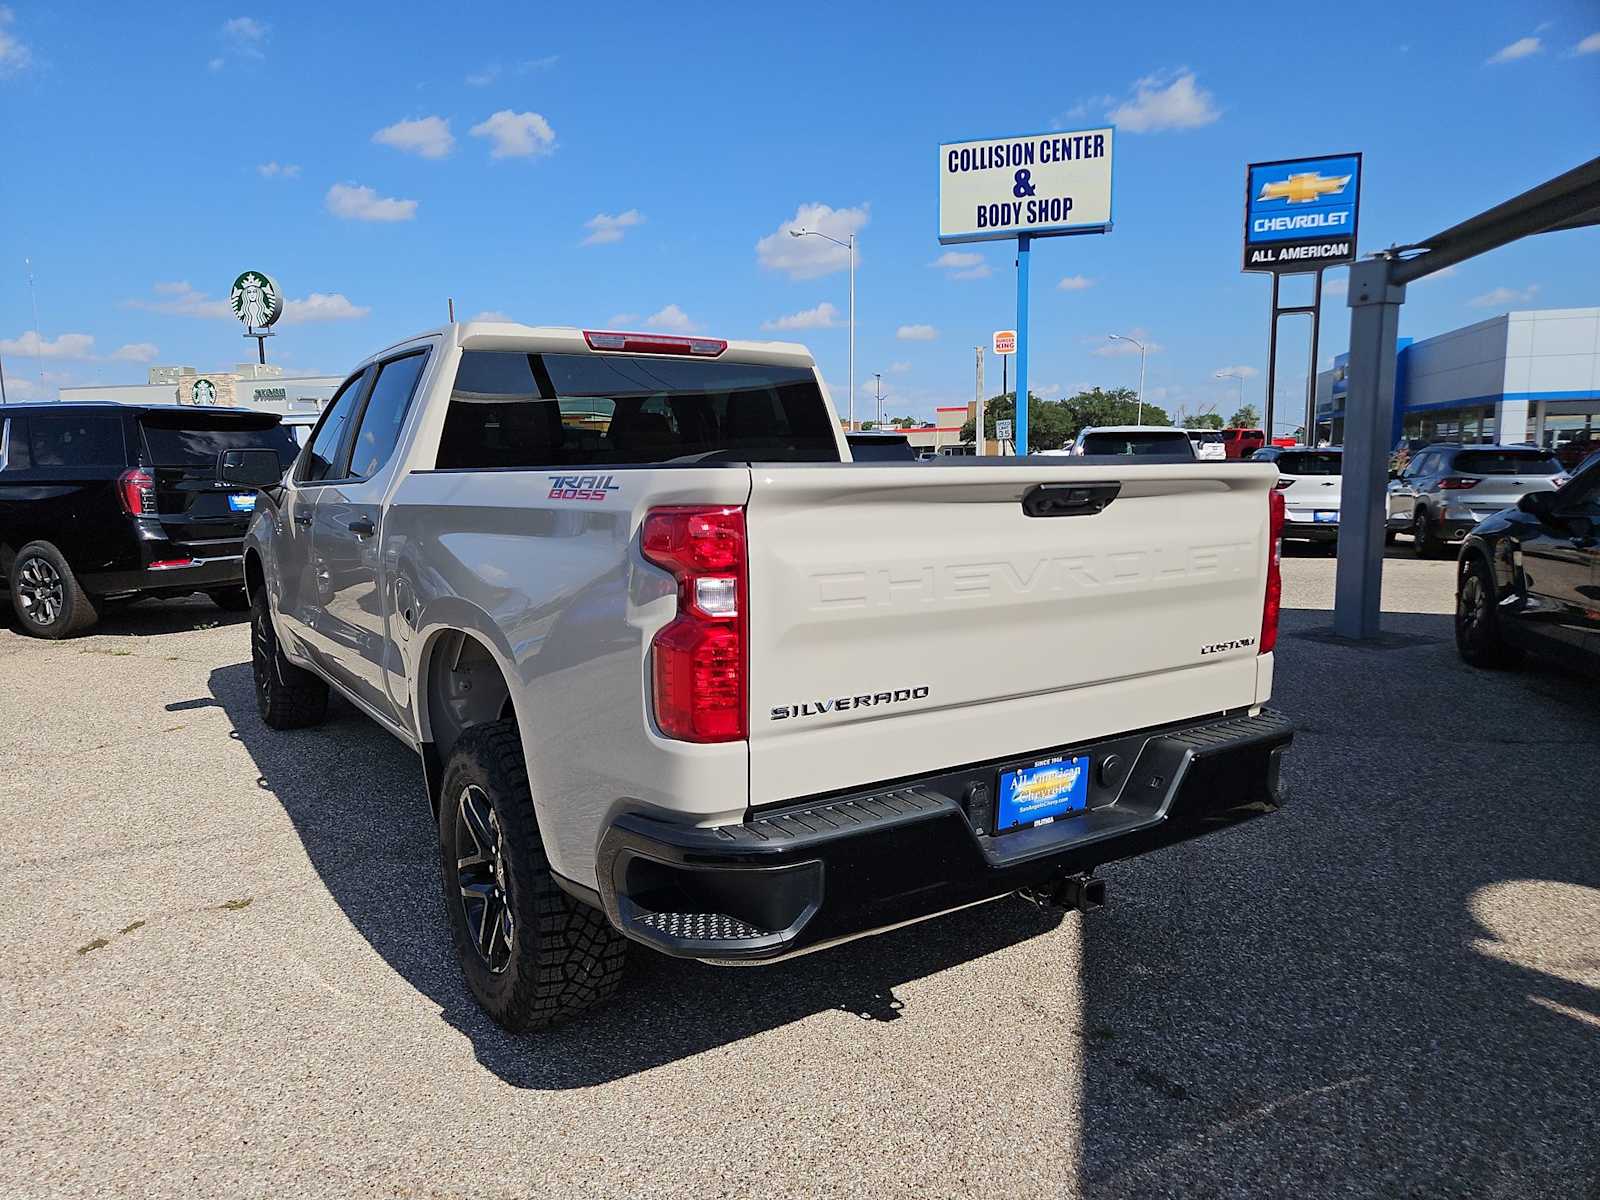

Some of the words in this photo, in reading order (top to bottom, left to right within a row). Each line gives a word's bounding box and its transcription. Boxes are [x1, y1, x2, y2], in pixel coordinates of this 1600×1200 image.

[948, 141, 1035, 173] COLLISION
[1039, 134, 1104, 164] CENTER
[1012, 168, 1036, 198] &
[977, 201, 1022, 228] BODY
[1026, 197, 1073, 224] SHOP
[1254, 211, 1349, 233] CHEVROLET
[1251, 249, 1276, 263] ALL
[1278, 243, 1349, 260] AMERICAN
[998, 430, 1011, 438] 35
[548, 475, 620, 490] TRAIL
[547, 488, 608, 501] BOSS
[808, 541, 1252, 611] CHEVROLET
[770, 686, 930, 721] SILVERADO
[1009, 775, 1028, 790] All
[1032, 766, 1081, 784] American
[1019, 782, 1072, 803] Chevrolet
